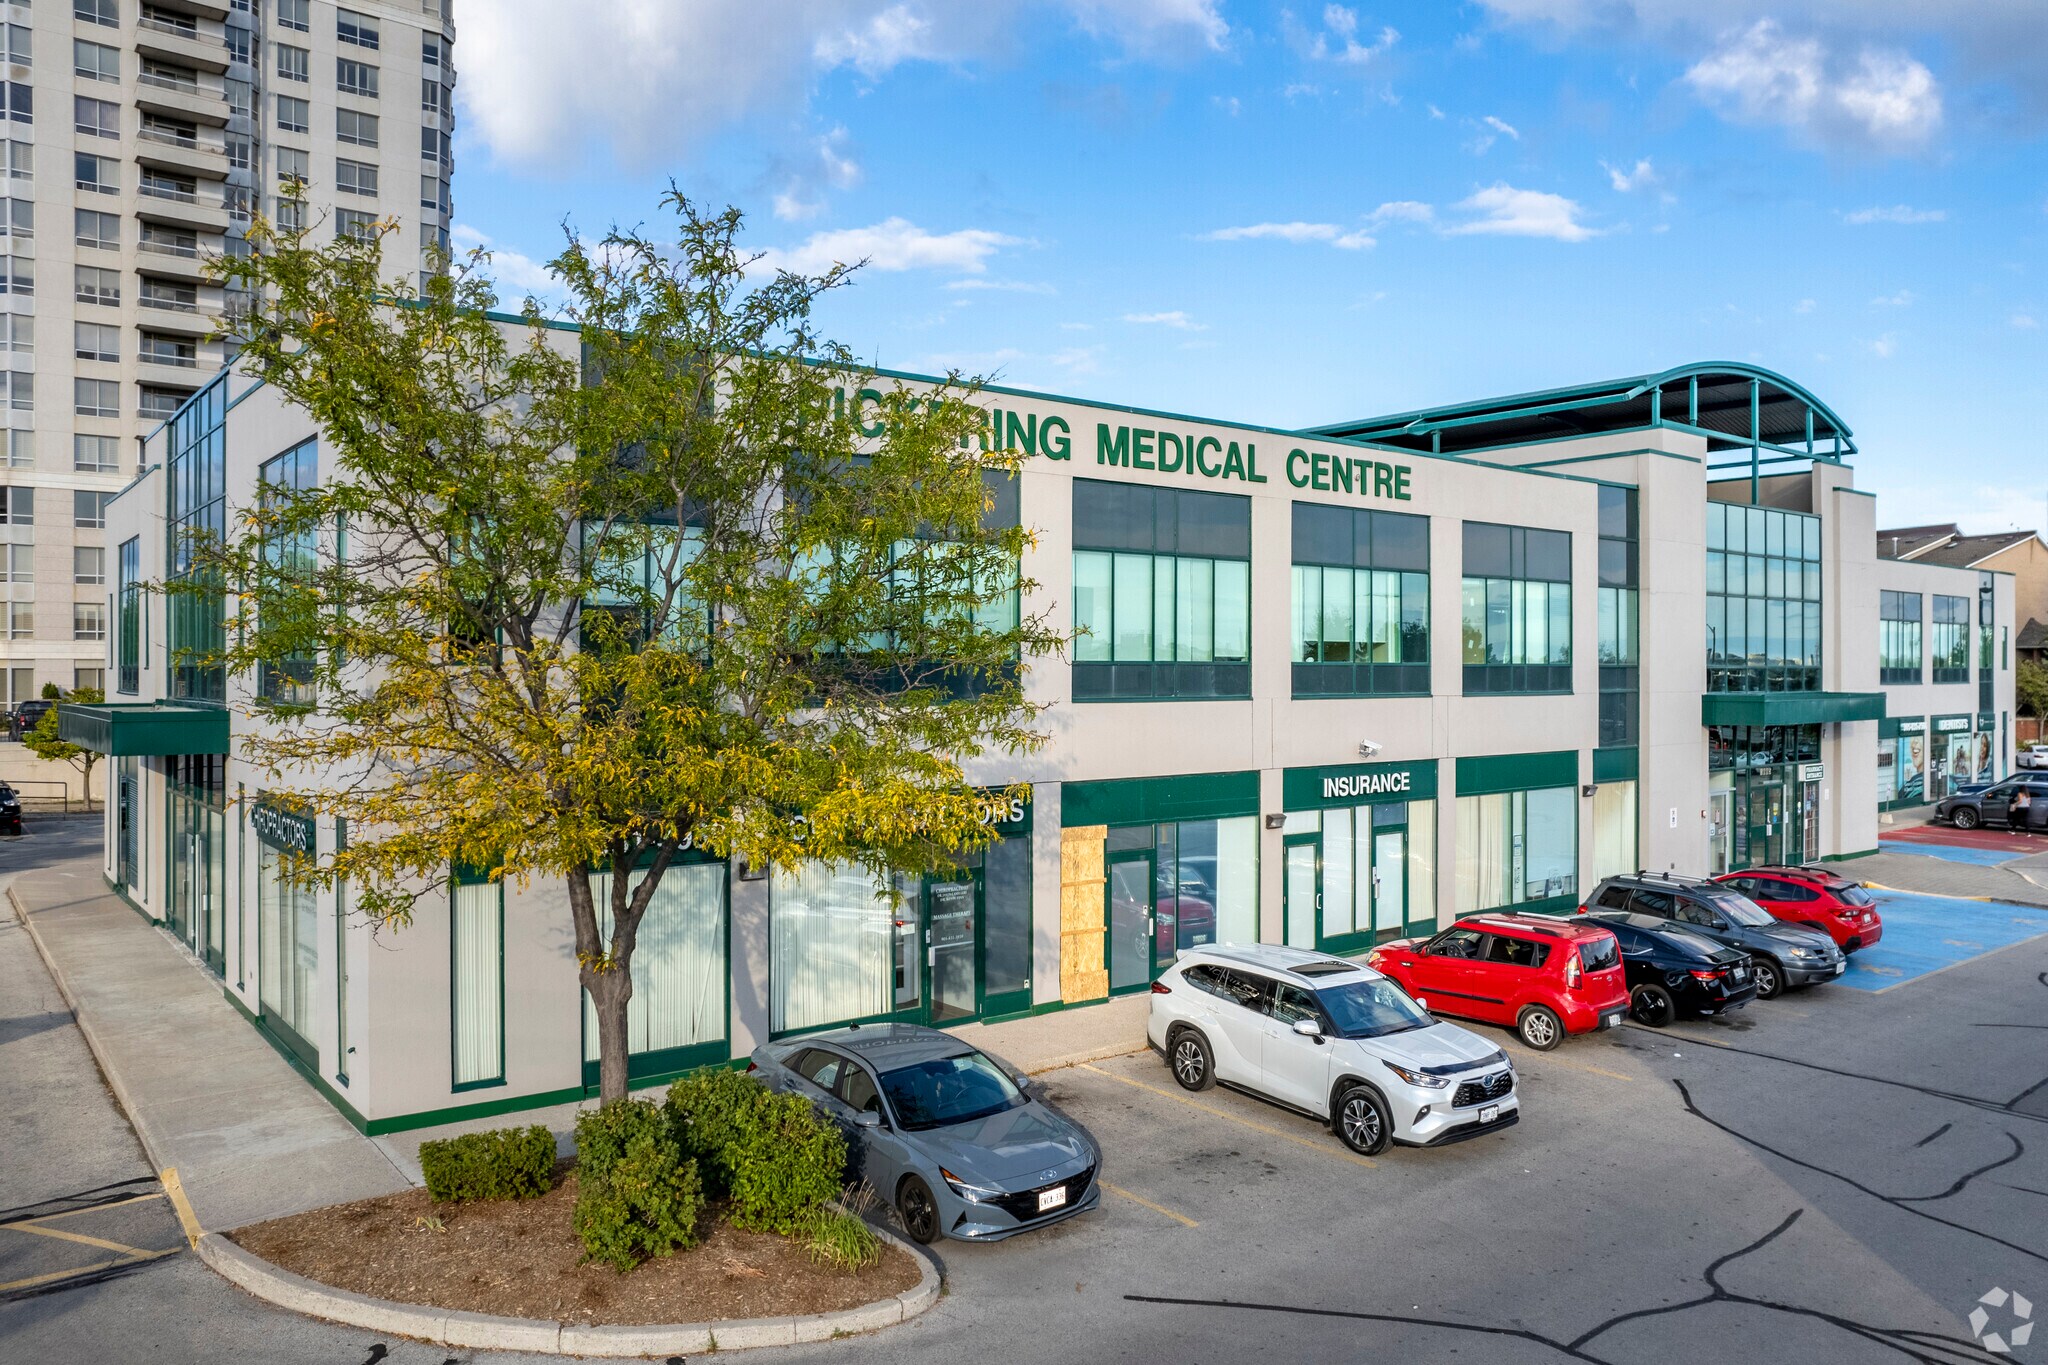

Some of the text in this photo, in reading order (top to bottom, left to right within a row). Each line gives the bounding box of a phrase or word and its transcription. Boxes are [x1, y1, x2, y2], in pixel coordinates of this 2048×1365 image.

[1097, 423, 1267, 483] MEDICAL
[1286, 448, 1412, 501] CENTRE
[1938, 718, 1969, 731] DENTISTS
[1323, 772, 1411, 798] INSURANCE
